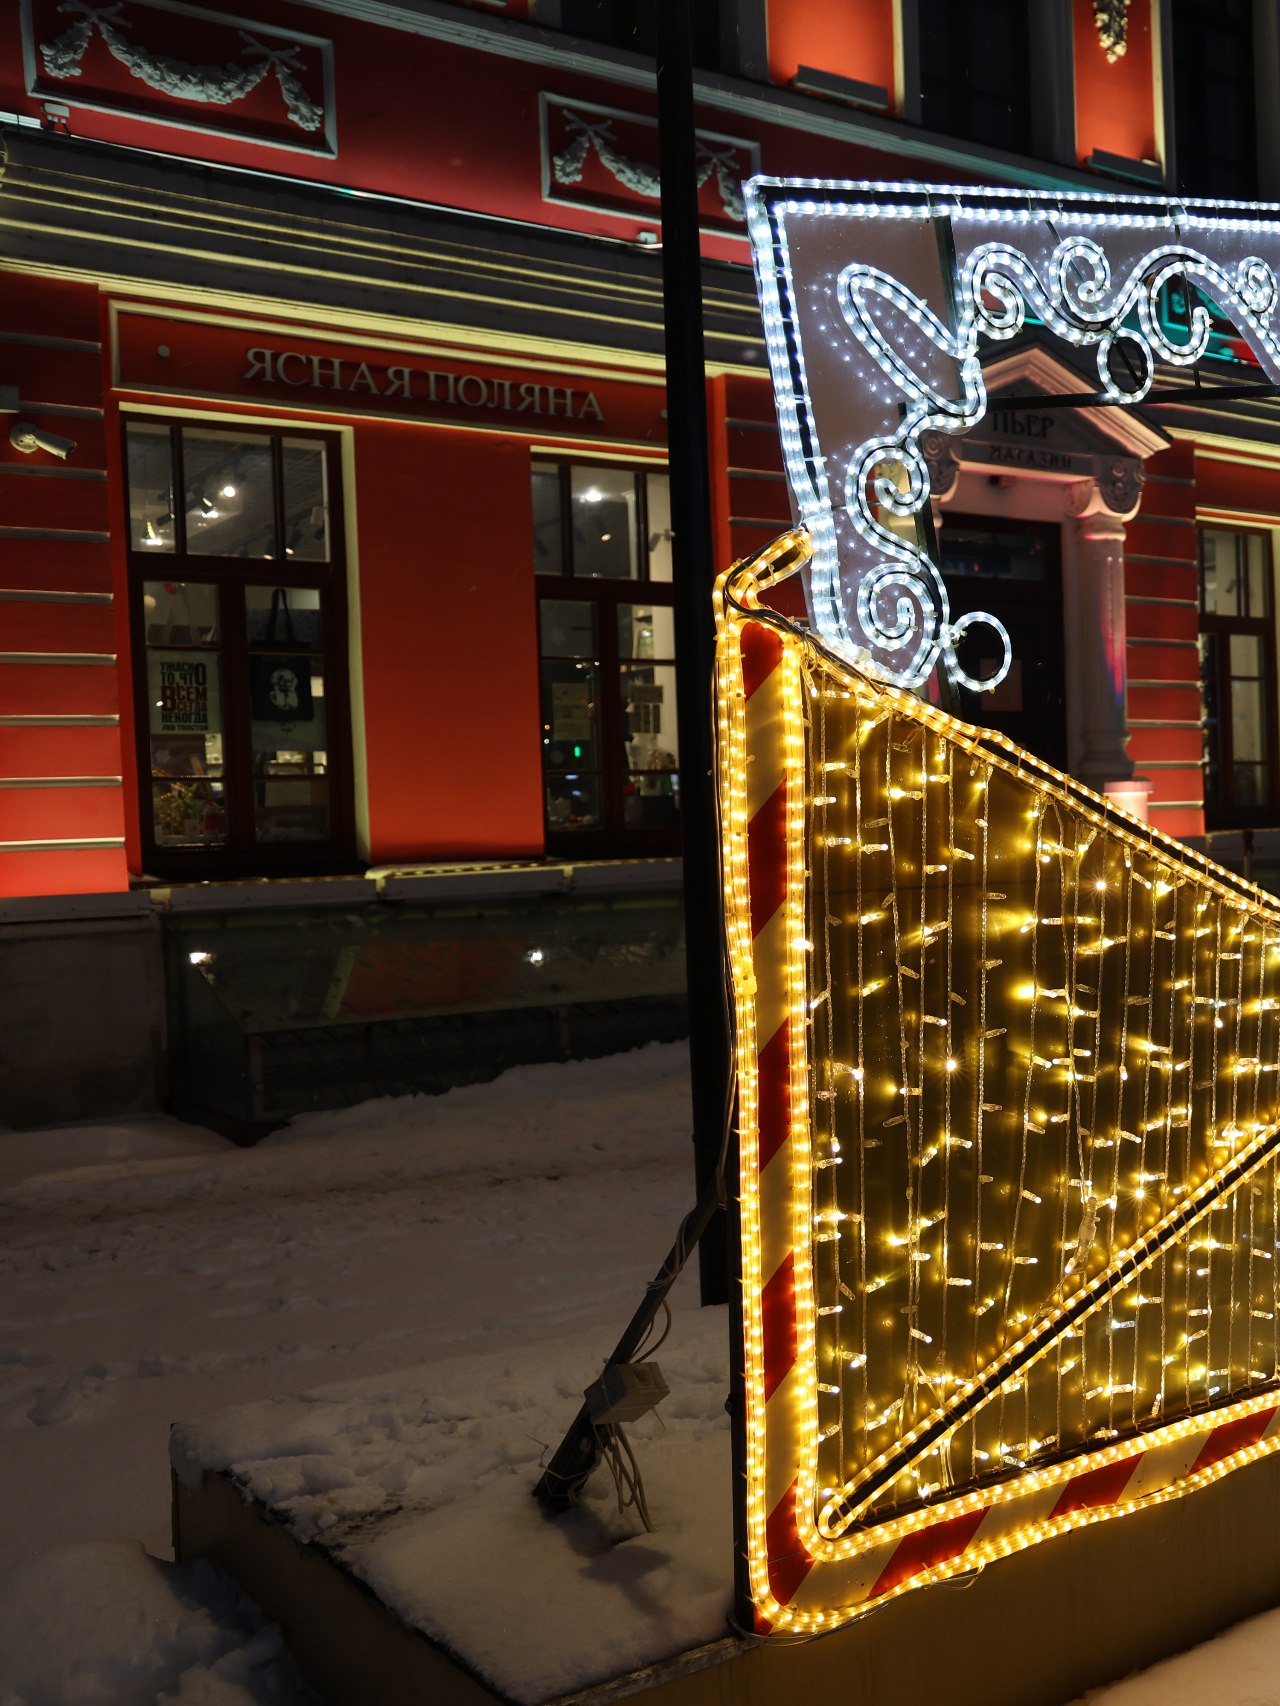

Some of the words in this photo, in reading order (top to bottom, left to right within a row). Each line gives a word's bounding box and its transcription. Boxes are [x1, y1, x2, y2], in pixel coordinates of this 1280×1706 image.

[242, 347, 413, 399] ЯСНАЯ
[426, 370, 605, 421] ПОЛЯНА
[992, 411, 1054, 438] ПЬЕР
[989, 445, 1072, 468] МАГАЗИН
